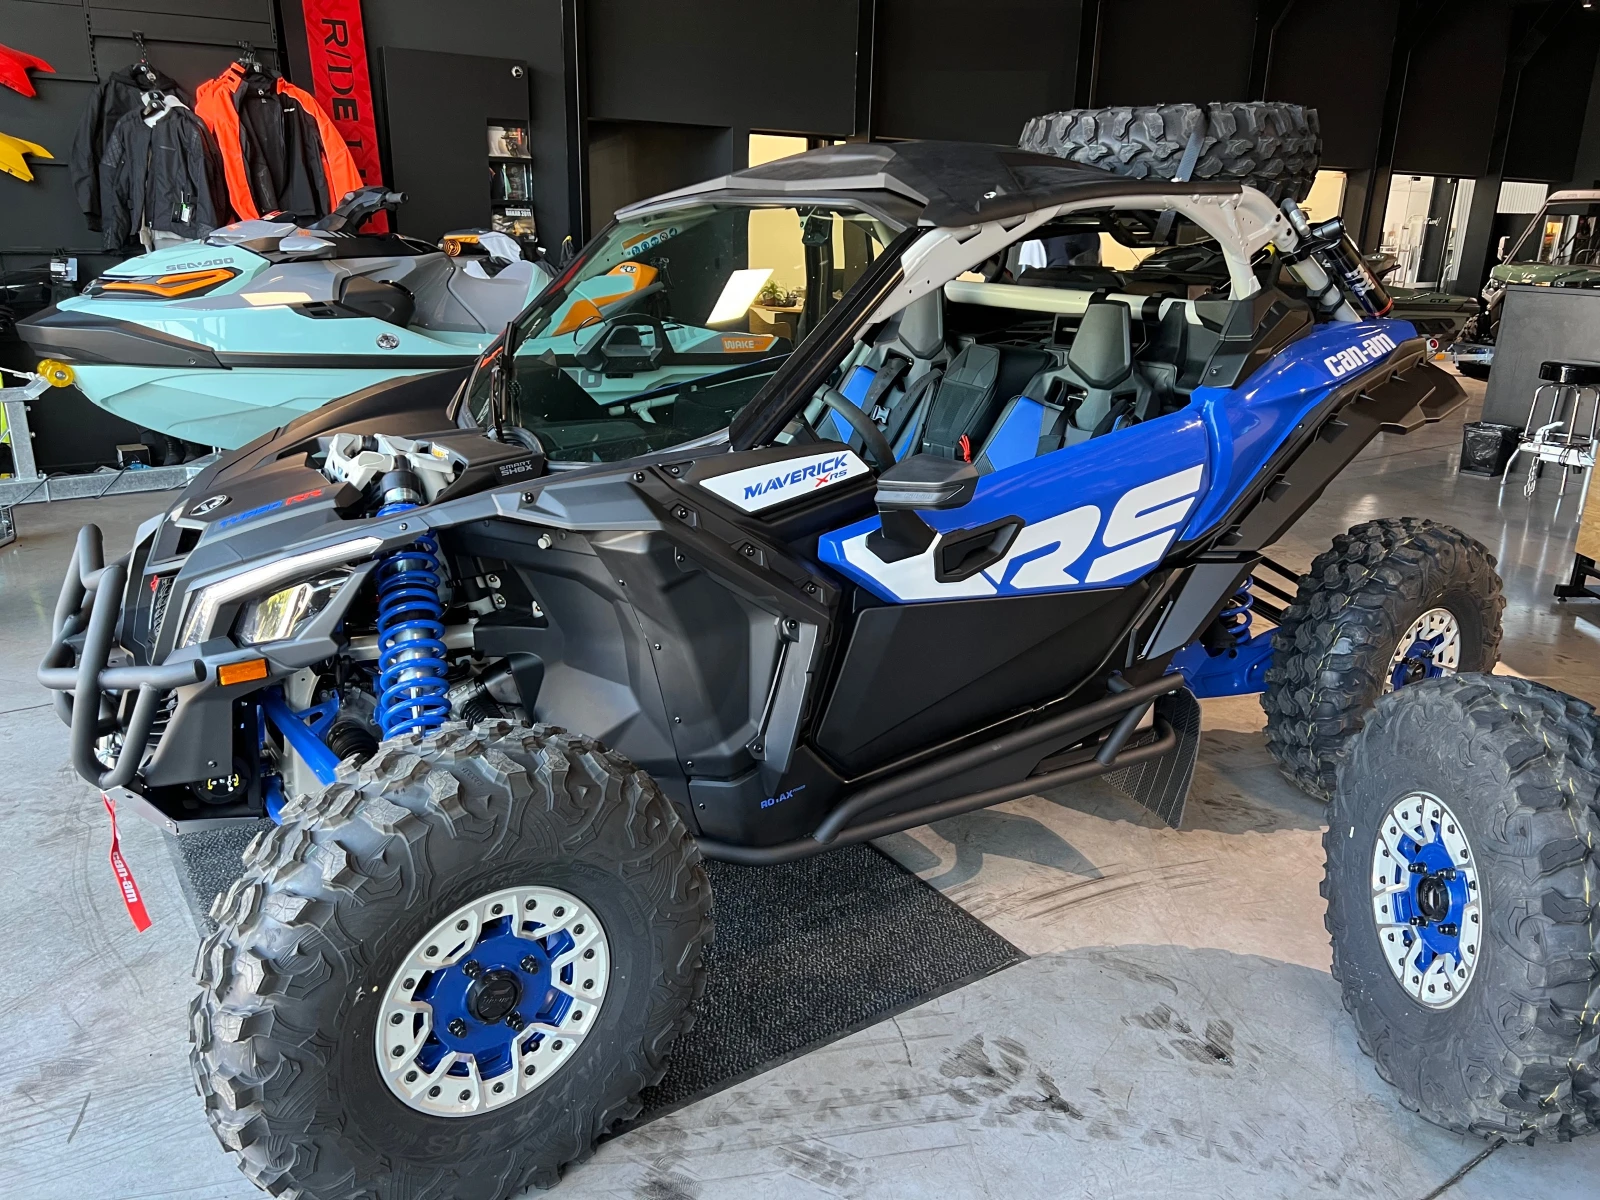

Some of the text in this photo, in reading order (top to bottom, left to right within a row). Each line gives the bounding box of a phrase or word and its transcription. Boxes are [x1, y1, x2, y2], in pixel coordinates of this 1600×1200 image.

[724, 340, 755, 350] WAKE
[1324, 332, 1397, 378] can-am
[499, 459, 531, 471] SMART
[500, 464, 533, 477] SHOX
[744, 452, 848, 500] MAVERICK
